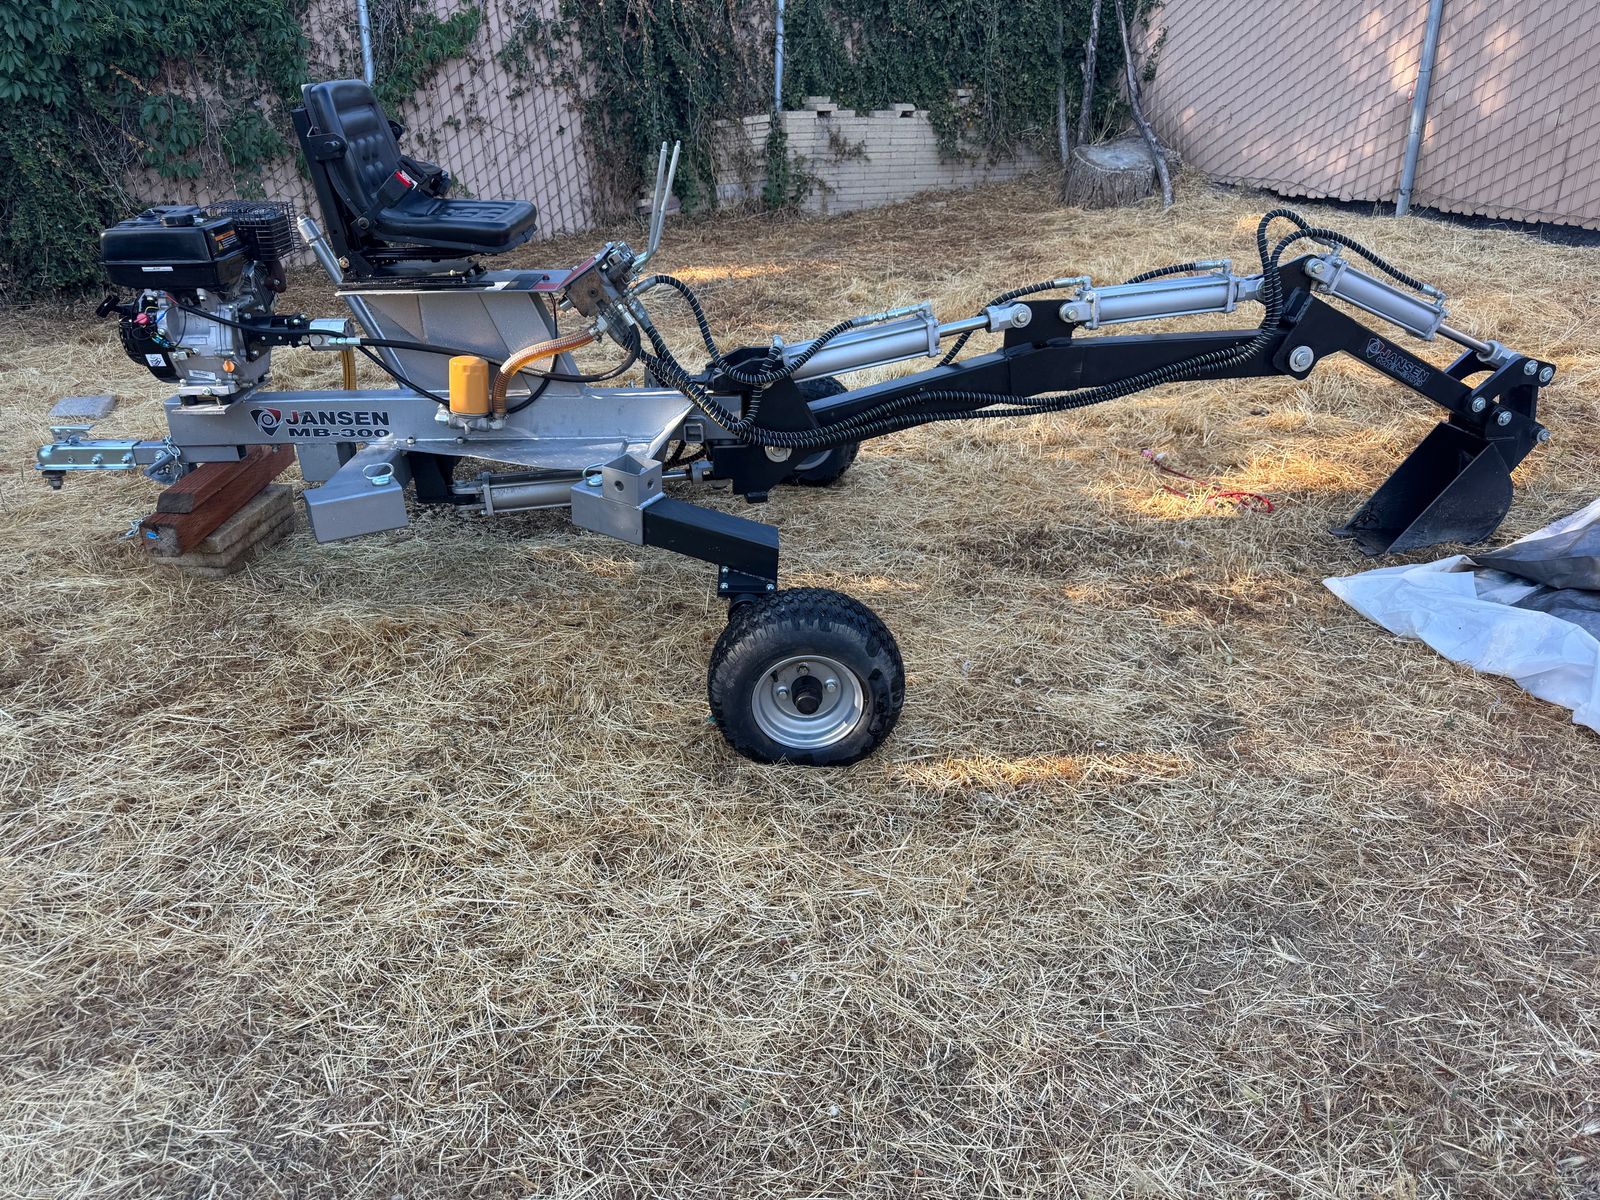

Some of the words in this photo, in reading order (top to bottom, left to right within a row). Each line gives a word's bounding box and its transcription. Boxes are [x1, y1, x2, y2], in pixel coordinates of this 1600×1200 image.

[1380, 349, 1430, 382] JANSEN
[285, 411, 390, 426] JANSEN
[288, 428, 390, 438] MB-300
